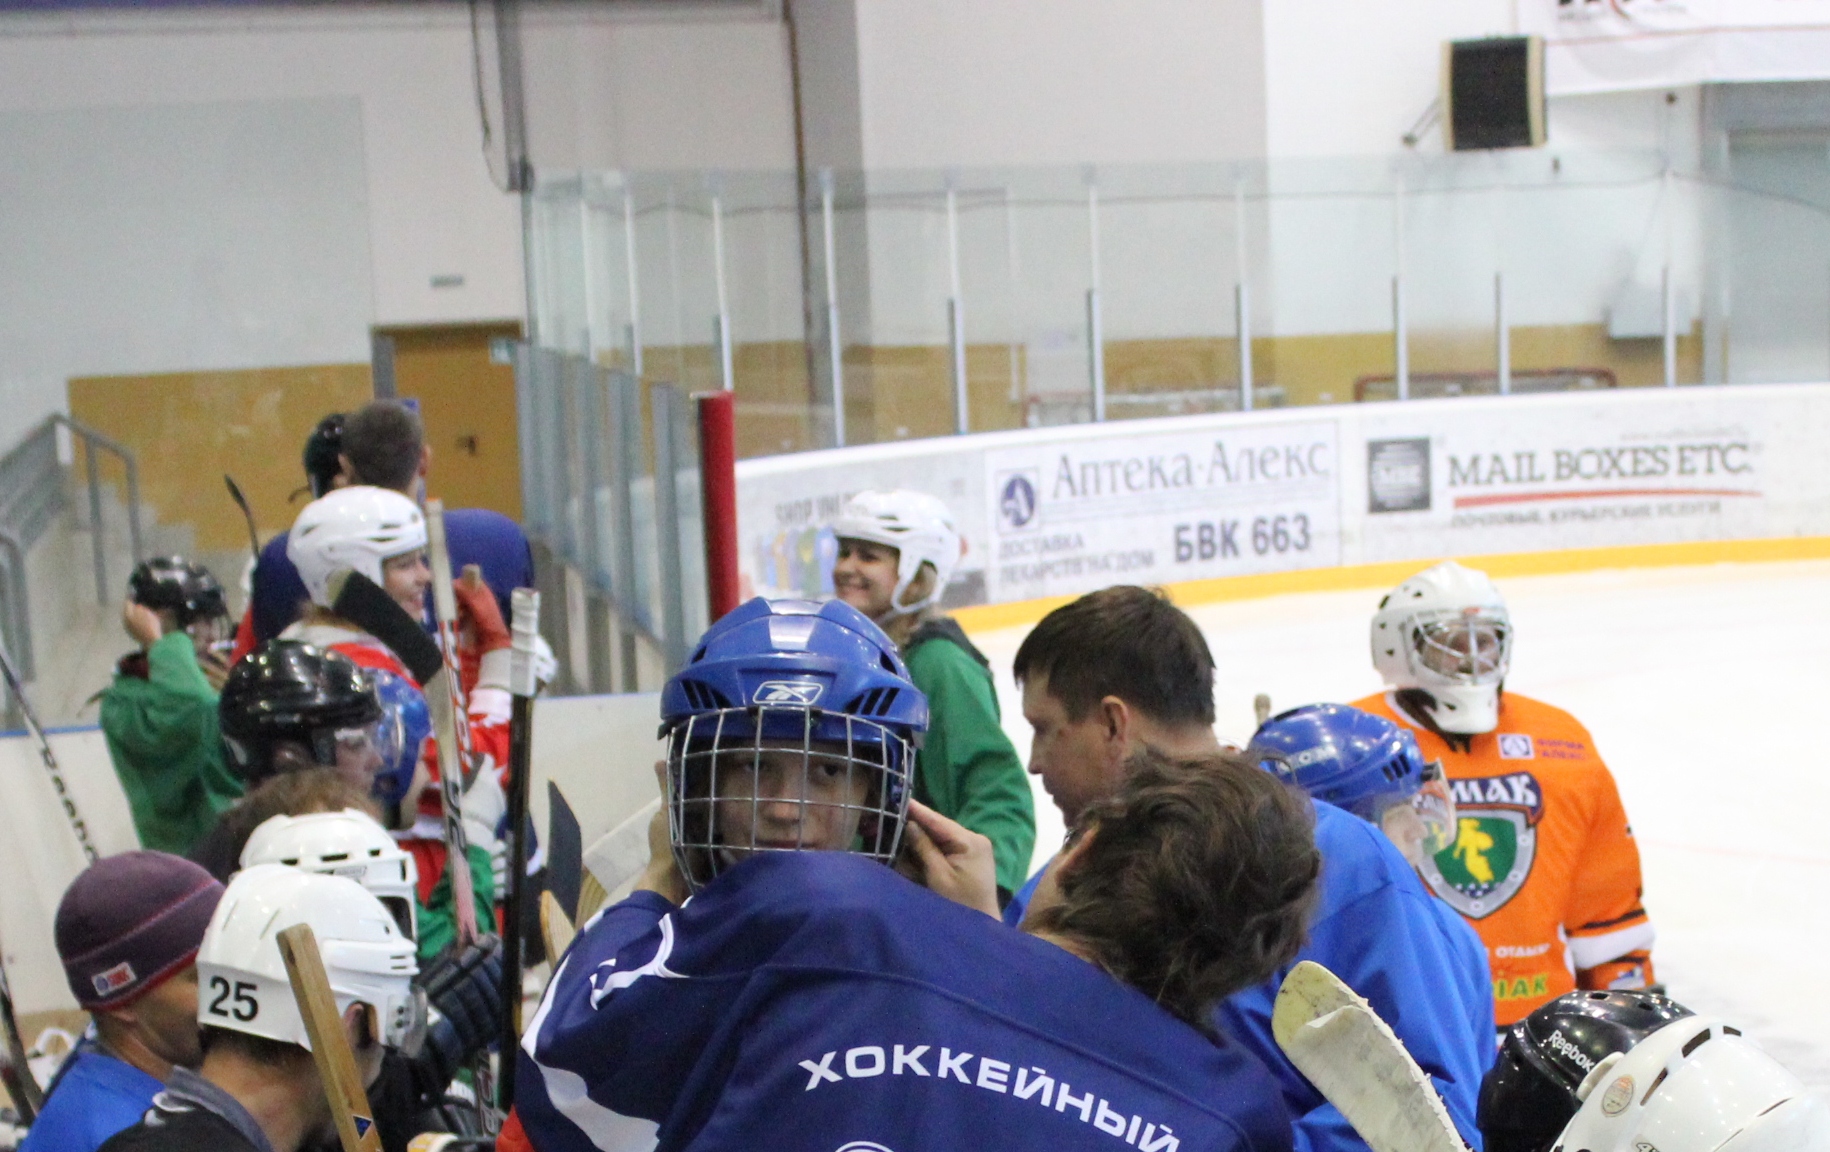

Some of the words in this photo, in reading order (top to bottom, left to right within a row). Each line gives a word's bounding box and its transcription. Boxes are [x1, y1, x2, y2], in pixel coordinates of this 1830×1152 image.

[1447, 451, 1545, 487] MAIL
[1553, 446, 1670, 481] BOXES
[1174, 519, 1240, 564] БВК
[1252, 512, 1312, 555] 663
[208, 975, 259, 1022] 25
[1548, 1029, 1597, 1075] Reebok
